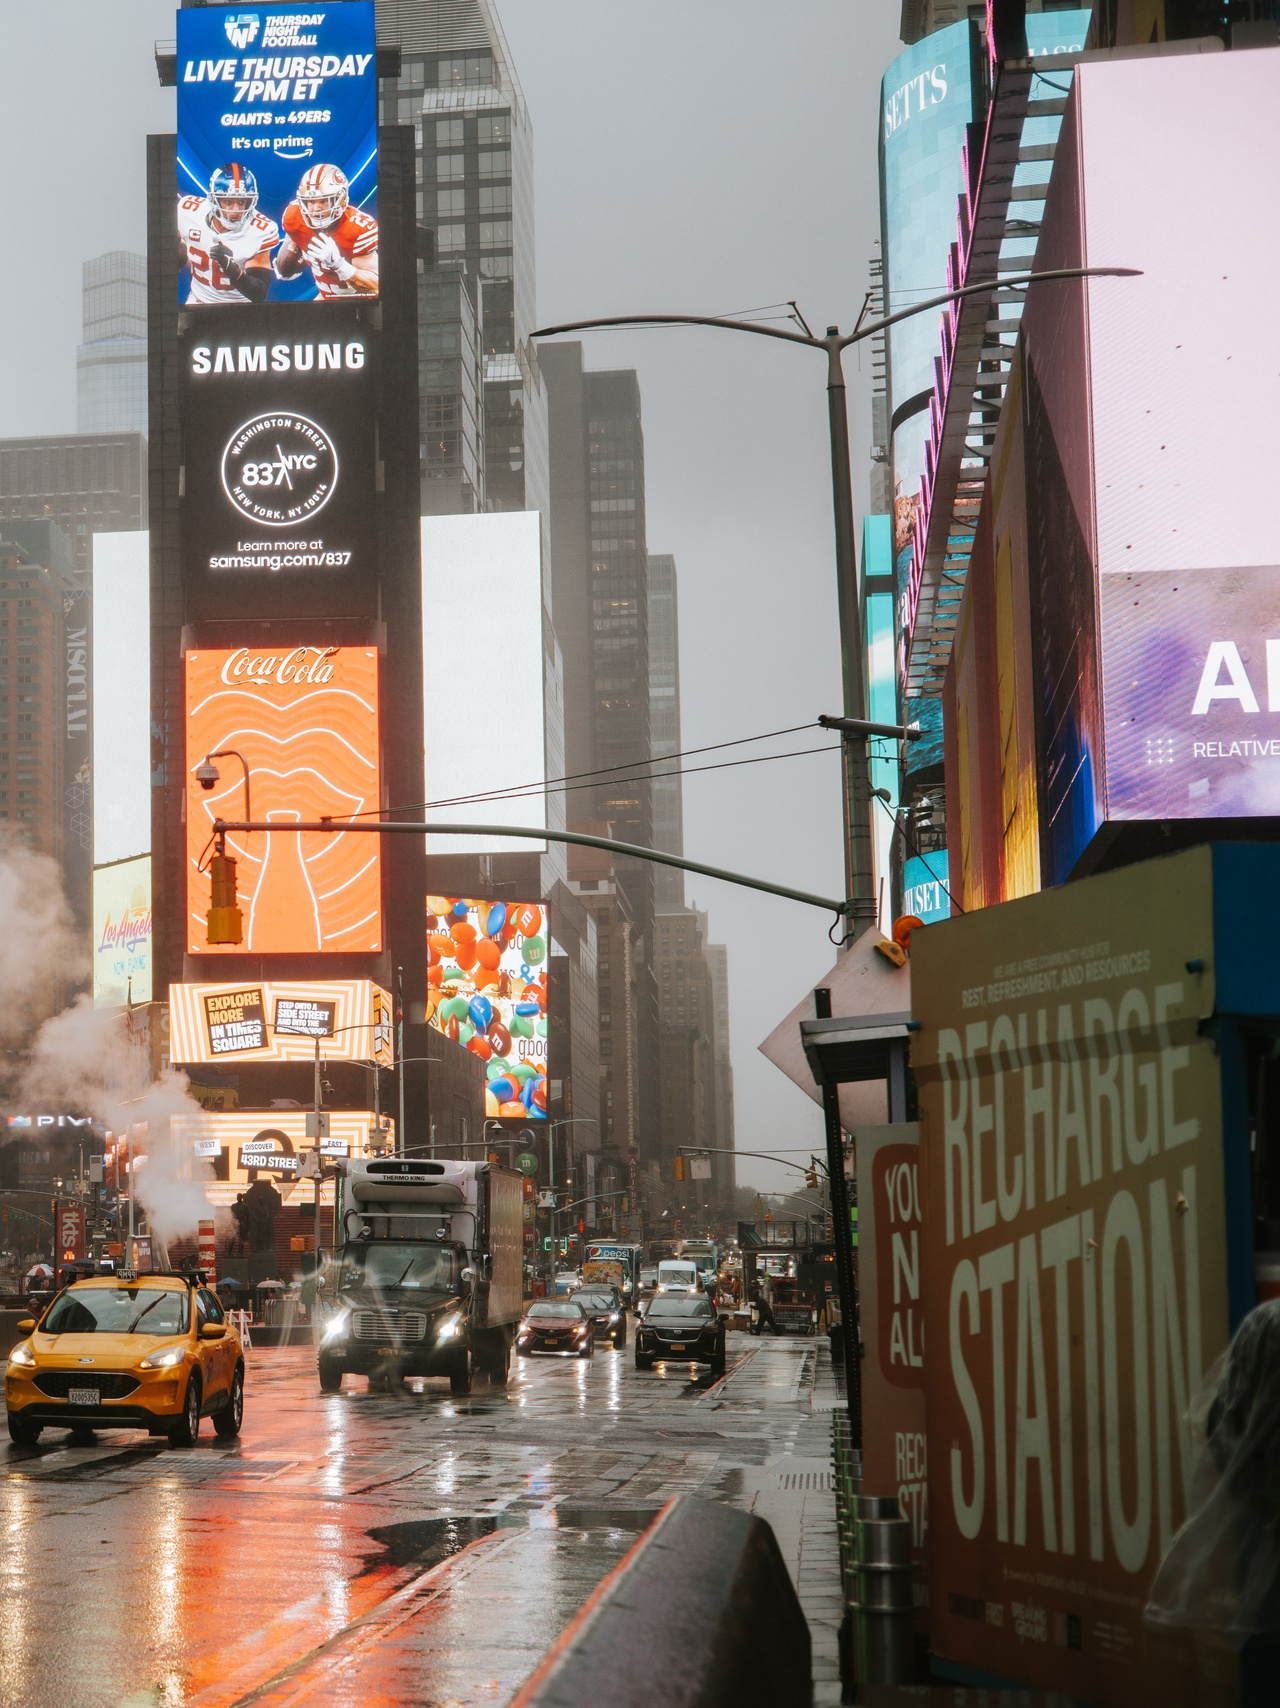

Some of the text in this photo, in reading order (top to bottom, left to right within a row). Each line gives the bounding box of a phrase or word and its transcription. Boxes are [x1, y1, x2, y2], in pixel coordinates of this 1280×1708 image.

[266, 14, 326, 26] THURSDAY
[264, 26, 300, 37] NIGHT
[262, 35, 318, 48] FOOTBALL
[183, 54, 373, 82] LIVE THURSDAY
[232, 78, 323, 103] 7PM ET
[220, 110, 331, 127] GIANTS 49ERS
[231, 134, 313, 150] It's on prime
[192, 343, 365, 374] SAMSUNG
[231, 418, 328, 456] WASHINGTON STREET
[280, 454, 317, 470] NYC
[232, 483, 328, 520] NEW YORK, NY 10014
[237, 540, 323, 551] Learn more at
[209, 552, 351, 570] samsung.com/837
[220, 646, 340, 686] Coca-Cola
[1191, 639, 1280, 715] A
[962, 949, 1151, 1009] REST, REFRESHMENT, AND RESOURCES
[208, 992, 261, 1012] EXPLORE
[278, 1001, 294, 1009] STEP
[209, 1008, 244, 1025] MORE
[277, 1010, 329, 1021] SIDE STREET
[292, 1019, 307, 1027] INTO
[308, 1020, 320, 1028] THE
[211, 1021, 262, 1039] IN TIMES
[212, 1034, 262, 1053] SQUARE
[37, 1115, 92, 1127] PIV
[937, 981, 1201, 1247] RECHARGE
[327, 1140, 343, 1148] EAST
[241, 1154, 297, 1168] 43RD STREE
[61, 1211, 80, 1249] tkts
[603, 1249, 630, 1259] pepsi
[890, 1309, 924, 1367] AL
[949, 1165, 1204, 1574] STATION
[895, 1432, 927, 1483] REC
